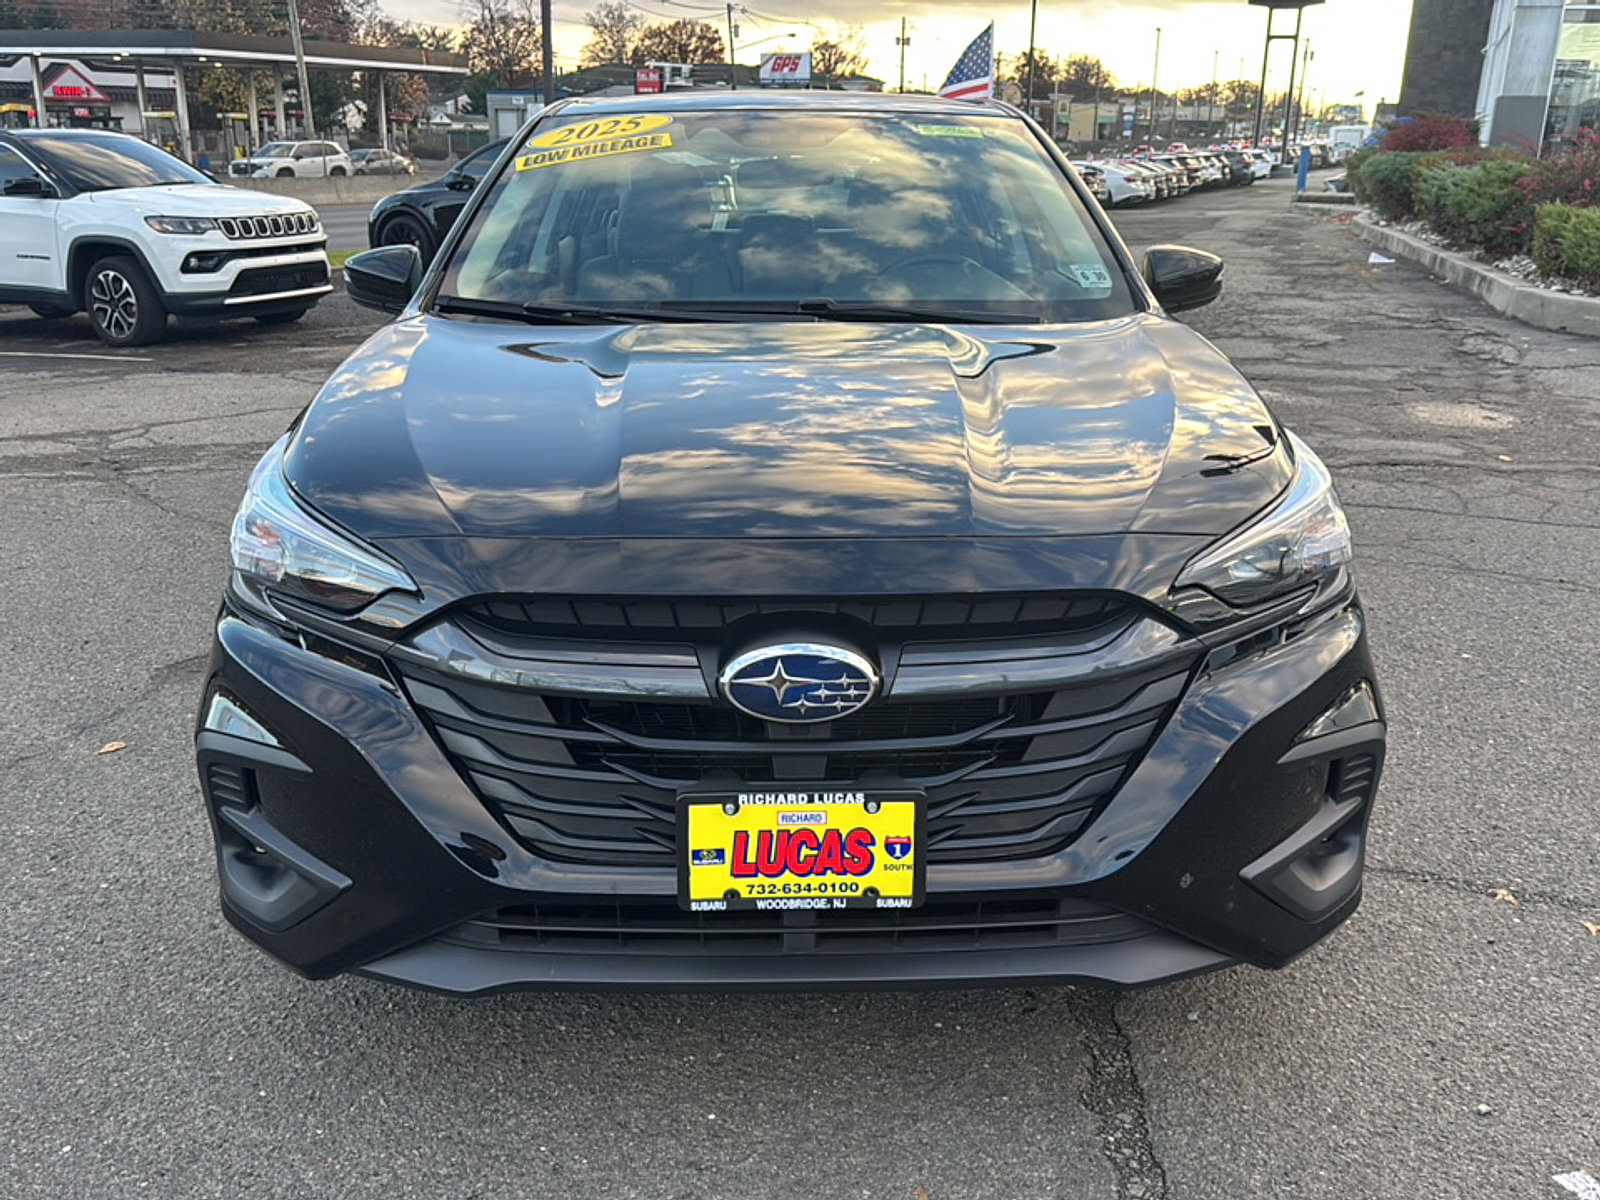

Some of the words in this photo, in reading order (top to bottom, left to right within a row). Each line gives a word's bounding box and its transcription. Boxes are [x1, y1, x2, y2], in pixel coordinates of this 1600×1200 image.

[771, 56, 802, 73] GPS
[552, 116, 645, 144] 2025
[523, 152, 569, 168] LOW
[570, 135, 664, 159] MILEAGE
[739, 793, 808, 804] RICHARD
[814, 792, 865, 804] LUCAS
[780, 813, 823, 824] RICHARD
[730, 827, 876, 878] LUCAS
[893, 843, 902, 857] 1
[883, 863, 913, 871] SOUTH
[746, 882, 860, 895] 732-634-0100
[690, 901, 727, 911] SUBARU
[833, 898, 847, 909] NJ
[876, 898, 913, 908] SUBARU
